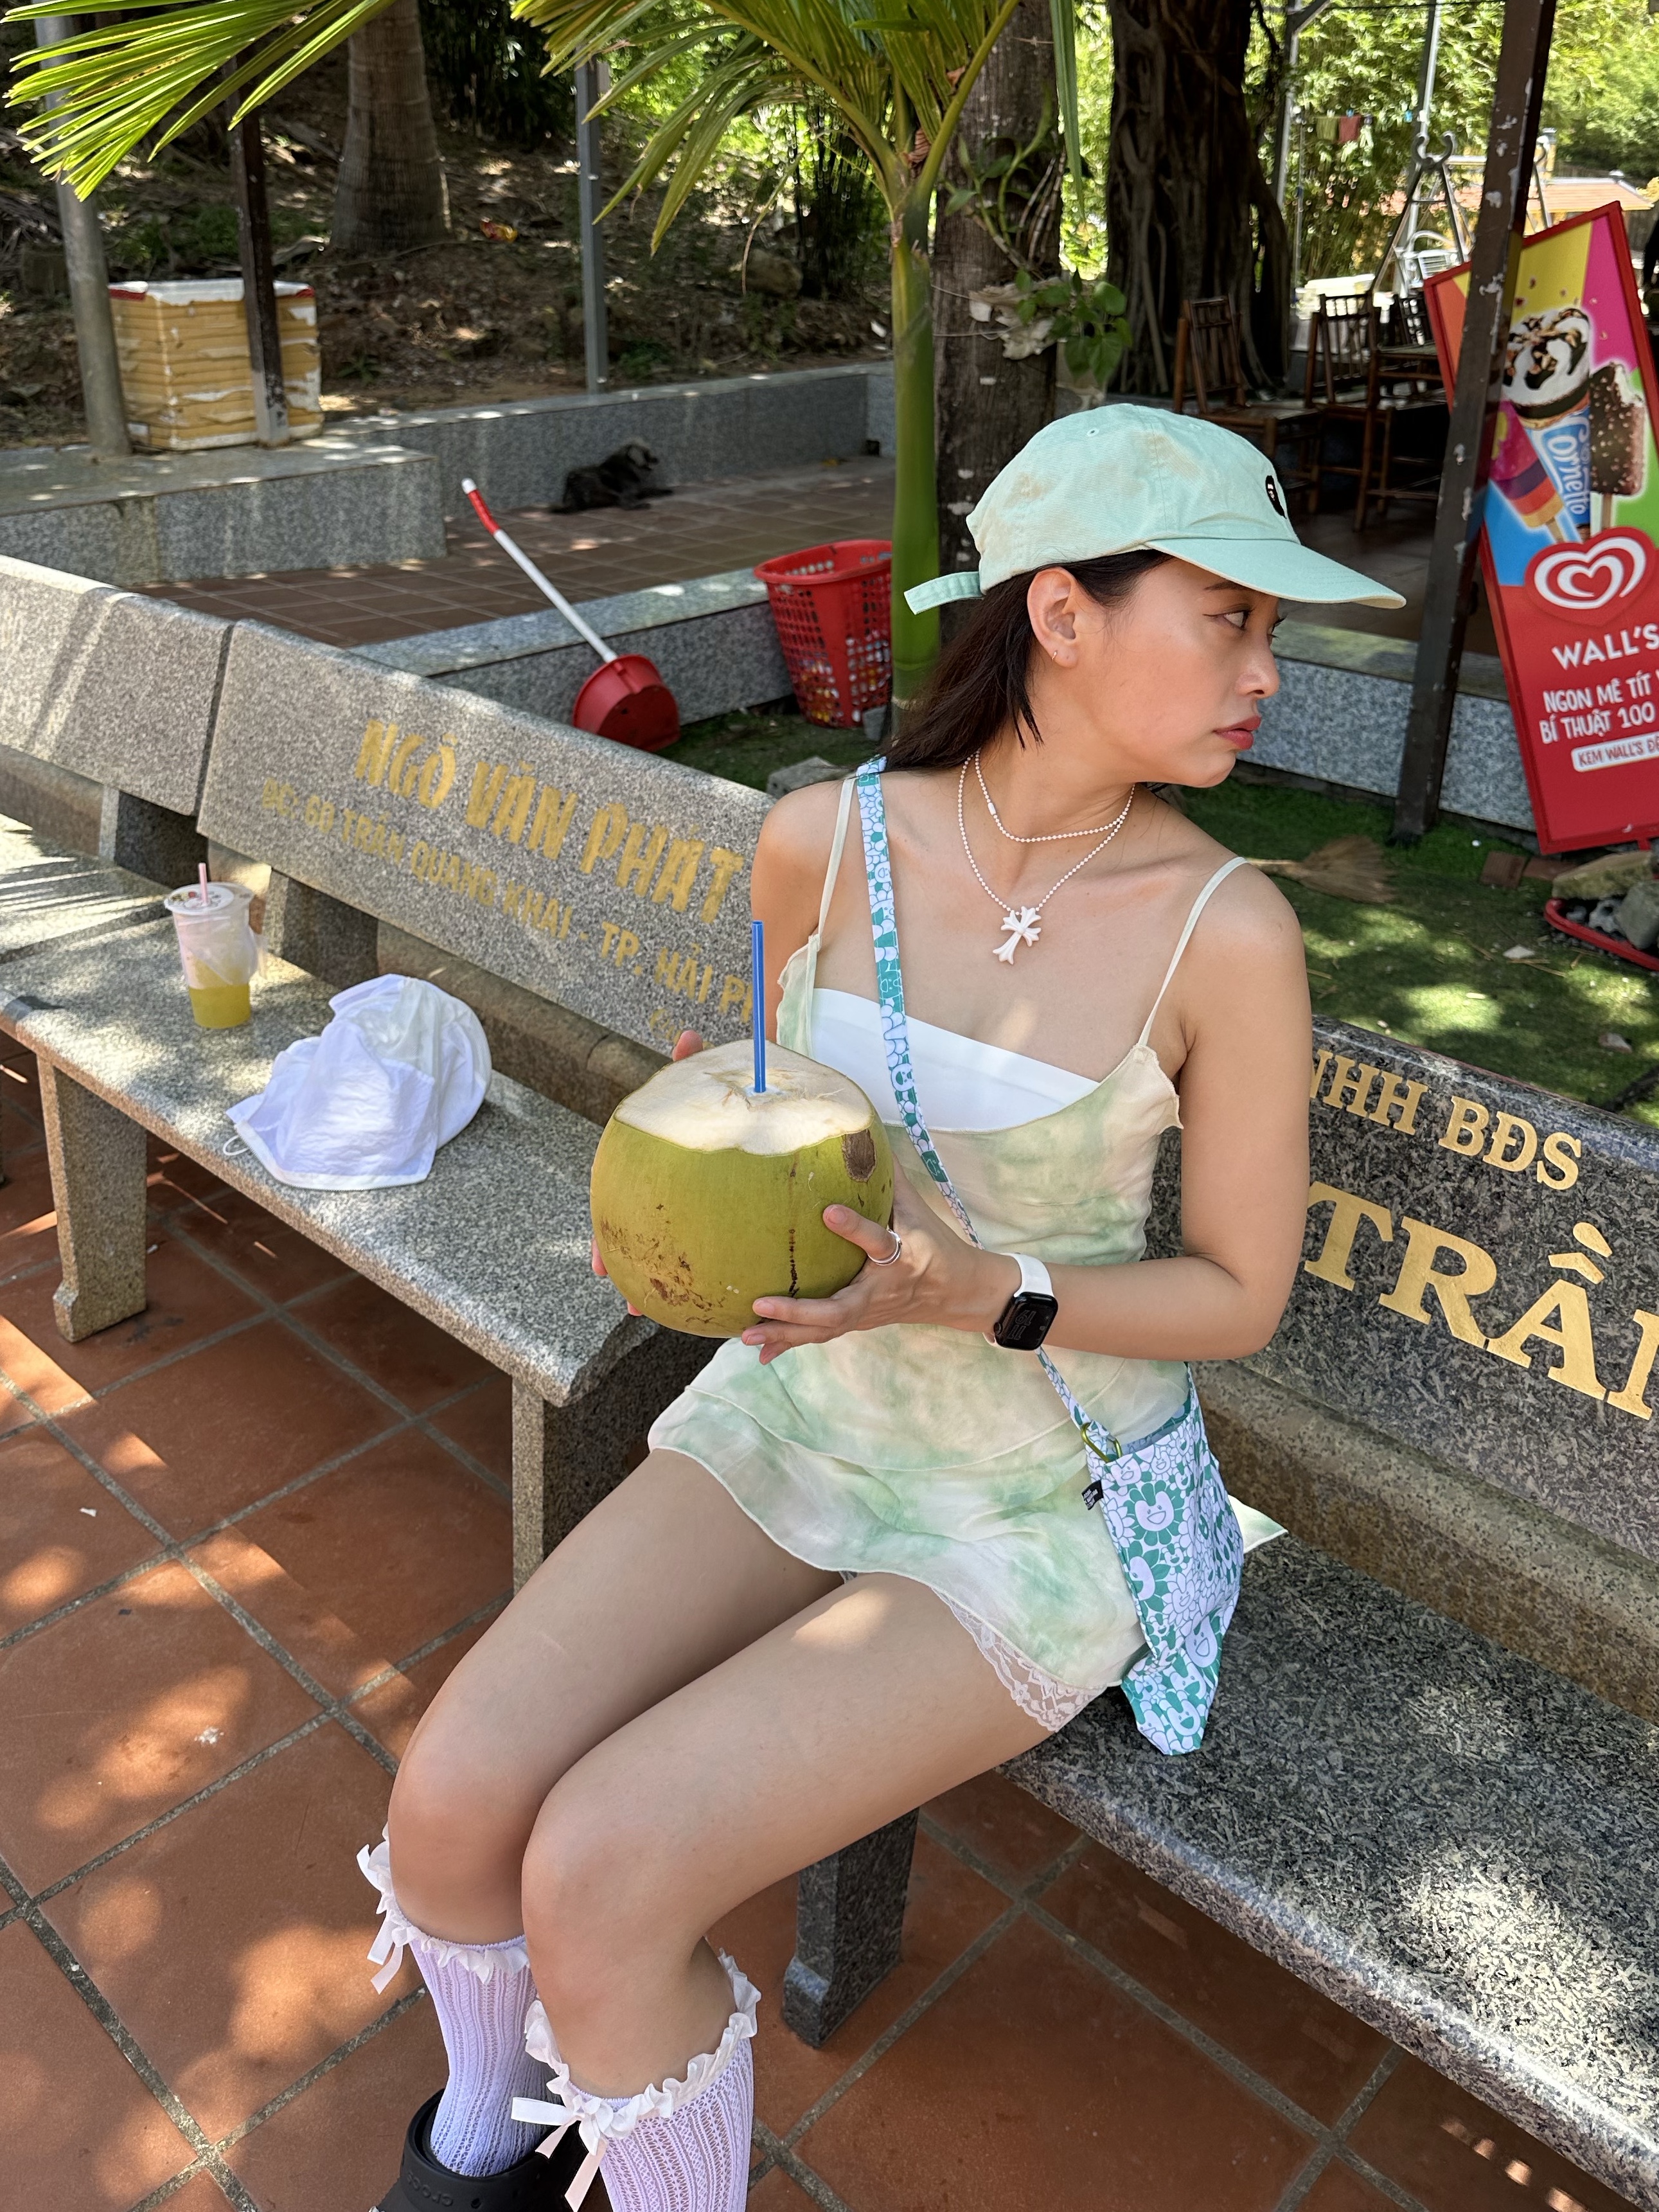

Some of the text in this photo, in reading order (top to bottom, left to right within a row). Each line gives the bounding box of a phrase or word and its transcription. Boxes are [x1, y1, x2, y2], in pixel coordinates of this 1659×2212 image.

[1529, 415, 1591, 515] Cornetto
[1551, 623, 1659, 671] WALL'S
[1539, 700, 1656, 745] BÍ THUẬT 100
[1543, 686, 1593, 713] NGON
[1596, 677, 1624, 706] MÊ
[1626, 670, 1651, 699] TÍT
[1578, 749, 1604, 768] KEM
[1606, 741, 1644, 761] WALL'S
[355, 719, 744, 924] NGÔ VĂN PHÁT
[305, 794, 335, 834] 60
[411, 841, 498, 907] QUANG
[601, 921, 643, 977] TP.
[654, 942, 713, 1004] HẢI
[1438, 1095, 1582, 1190] BĐS
